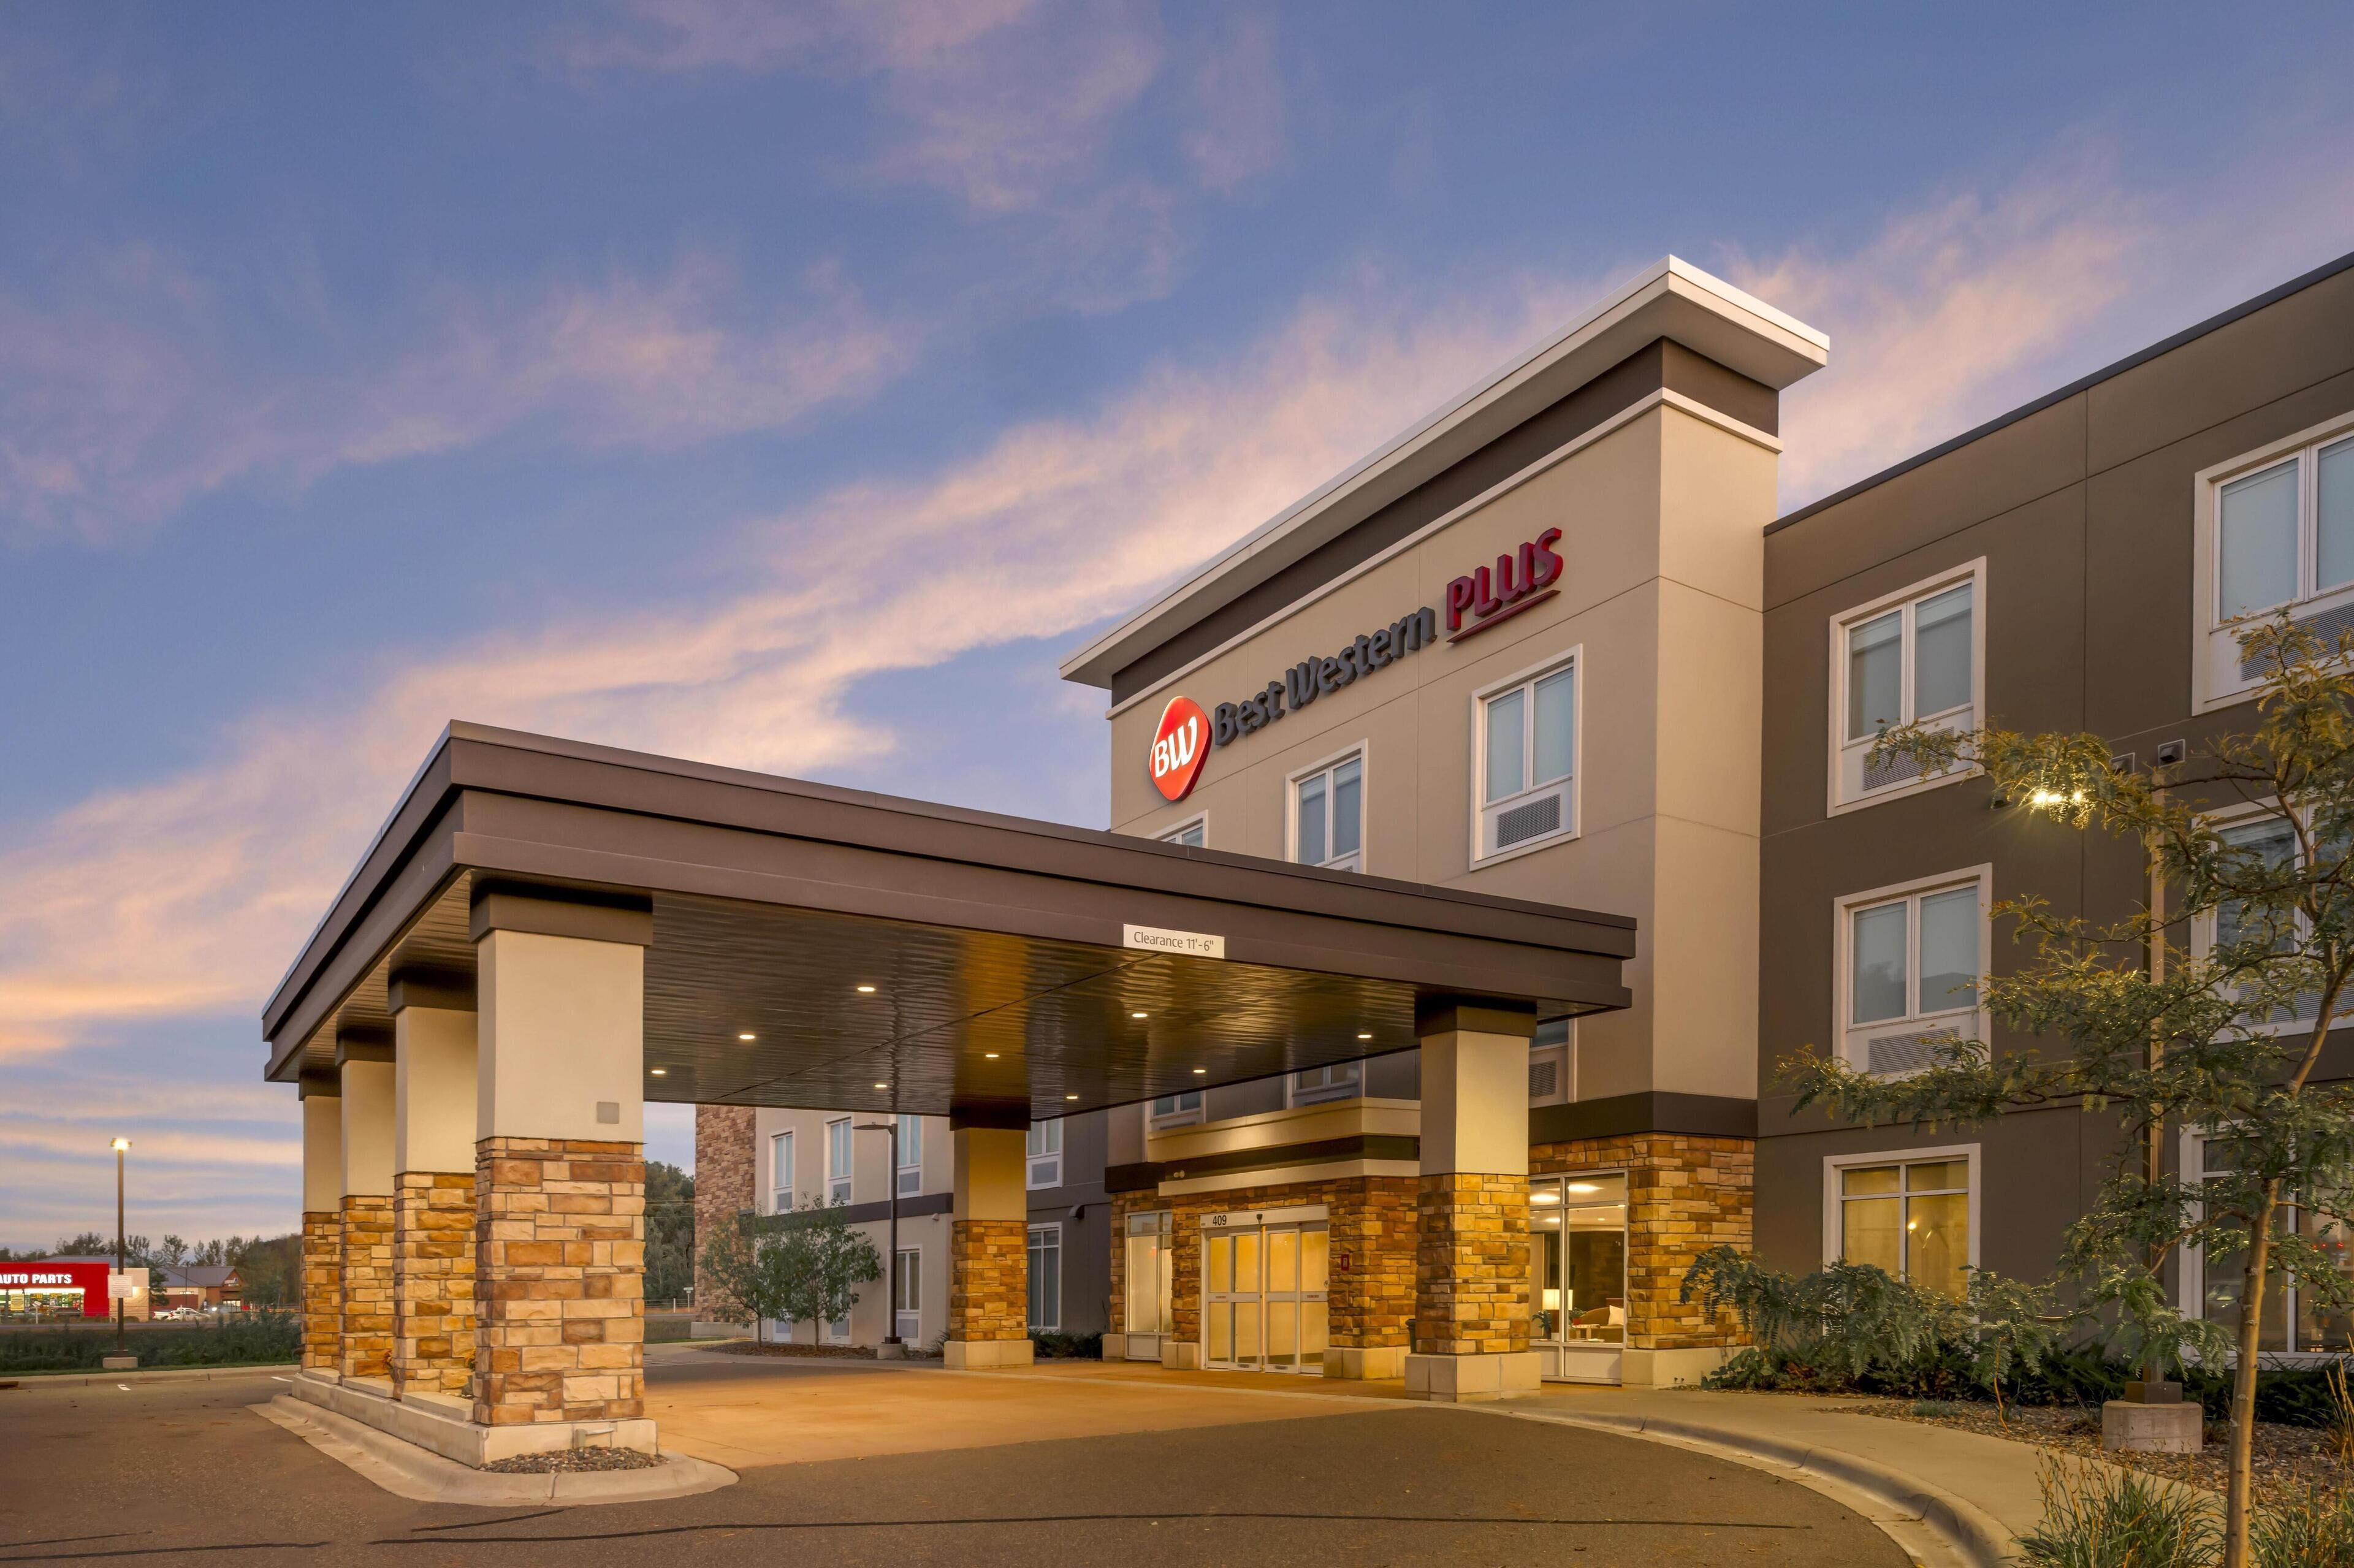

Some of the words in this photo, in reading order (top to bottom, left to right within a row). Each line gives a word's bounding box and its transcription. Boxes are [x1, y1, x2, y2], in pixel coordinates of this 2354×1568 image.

[1215, 680, 1286, 746] Best
[1286, 606, 1438, 710] Western
[1446, 527, 1563, 631] PLUS
[1154, 716, 1198, 778] BW
[1133, 931, 1183, 948] Clearance
[1212, 1214, 1227, 1226] 409
[32, 1274, 72, 1284] PARTS
